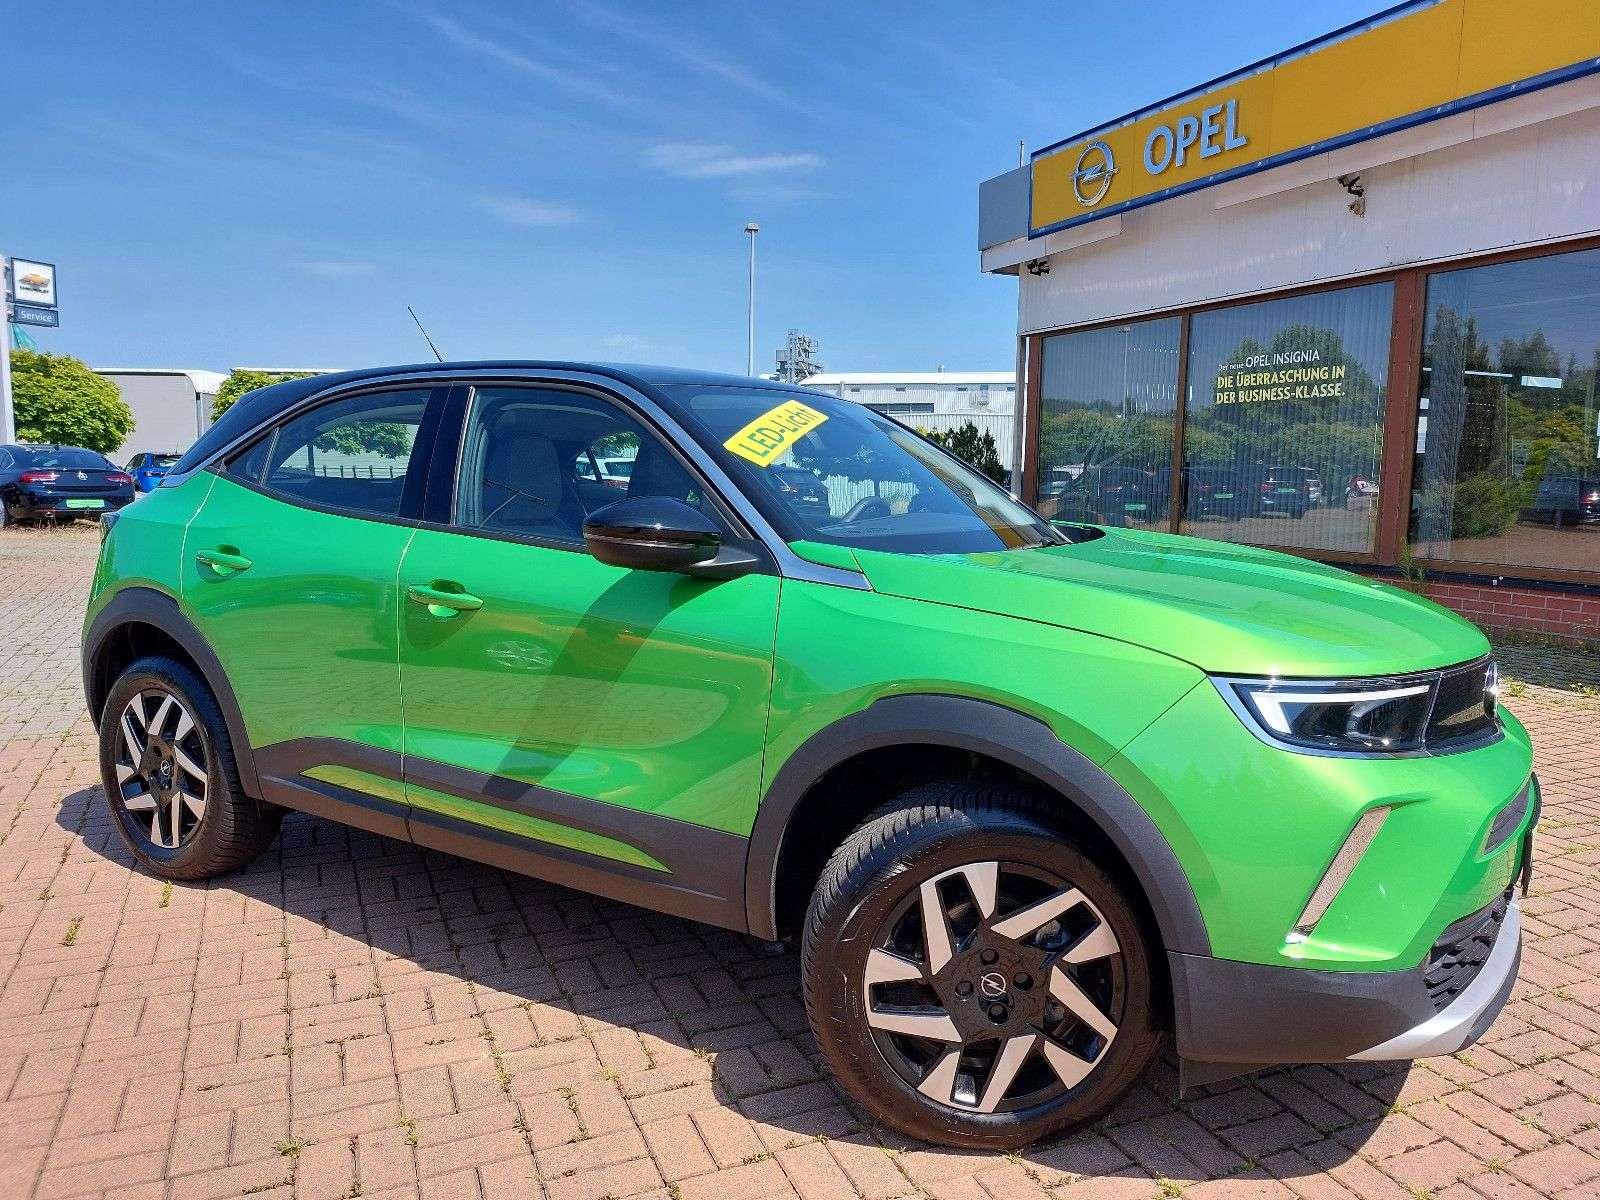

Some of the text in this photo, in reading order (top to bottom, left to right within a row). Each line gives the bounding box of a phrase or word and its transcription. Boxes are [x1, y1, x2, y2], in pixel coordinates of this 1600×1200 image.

[1143, 98, 1248, 175] OPEL
[21, 311, 52, 321] Service
[1246, 355, 1271, 367] OPEL
[1273, 350, 1320, 365] INSIGNIA
[1217, 365, 1345, 388] DIE ÜBERRASCHUNG IN
[1216, 383, 1345, 404] DER BUSINESS-KLASSE.
[738, 406, 819, 457] LED-Licht
